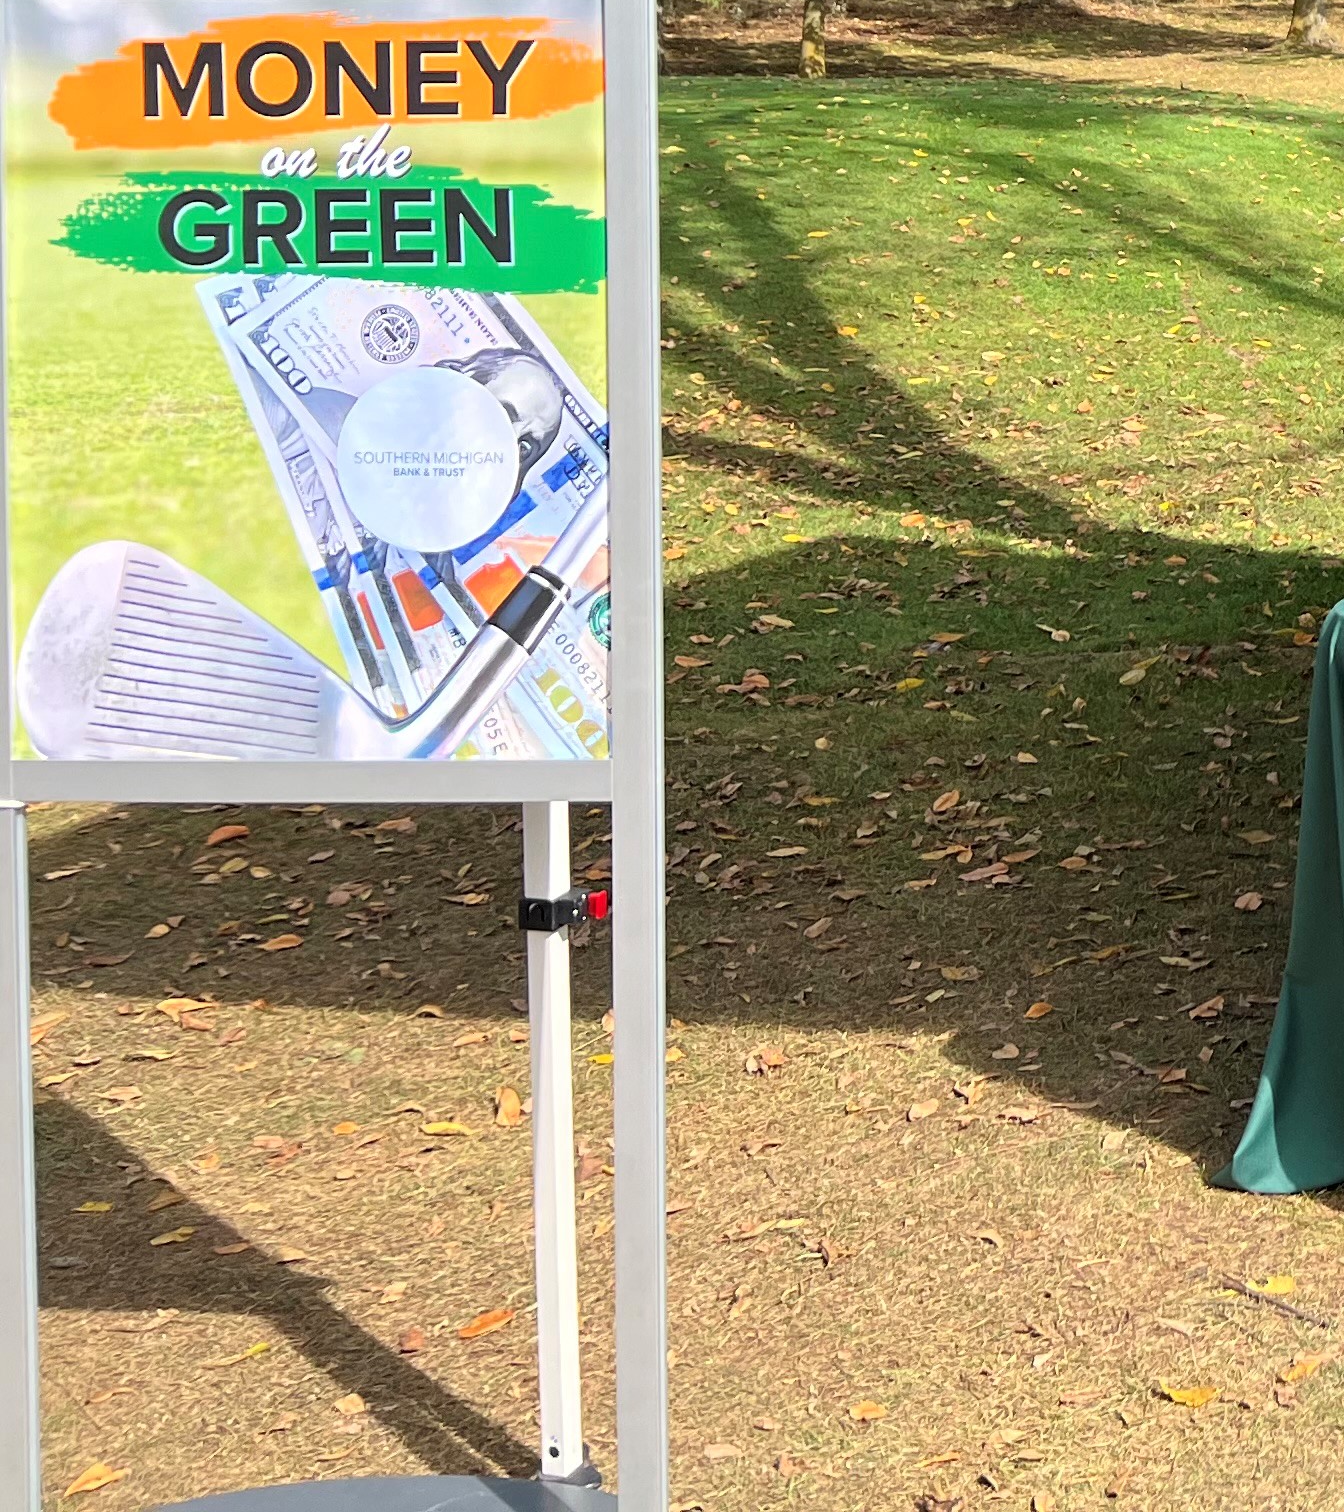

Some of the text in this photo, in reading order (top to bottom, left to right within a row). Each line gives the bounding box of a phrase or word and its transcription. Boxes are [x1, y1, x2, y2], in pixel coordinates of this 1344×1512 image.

[142, 40, 537, 119] MONEY
[261, 124, 413, 179] on the
[157, 188, 516, 270] GREEN
[261, 333, 313, 395] 100
[354, 451, 504, 464] SOUTHERN MICHIGAN
[393, 468, 466, 477] BANK & TRUST
